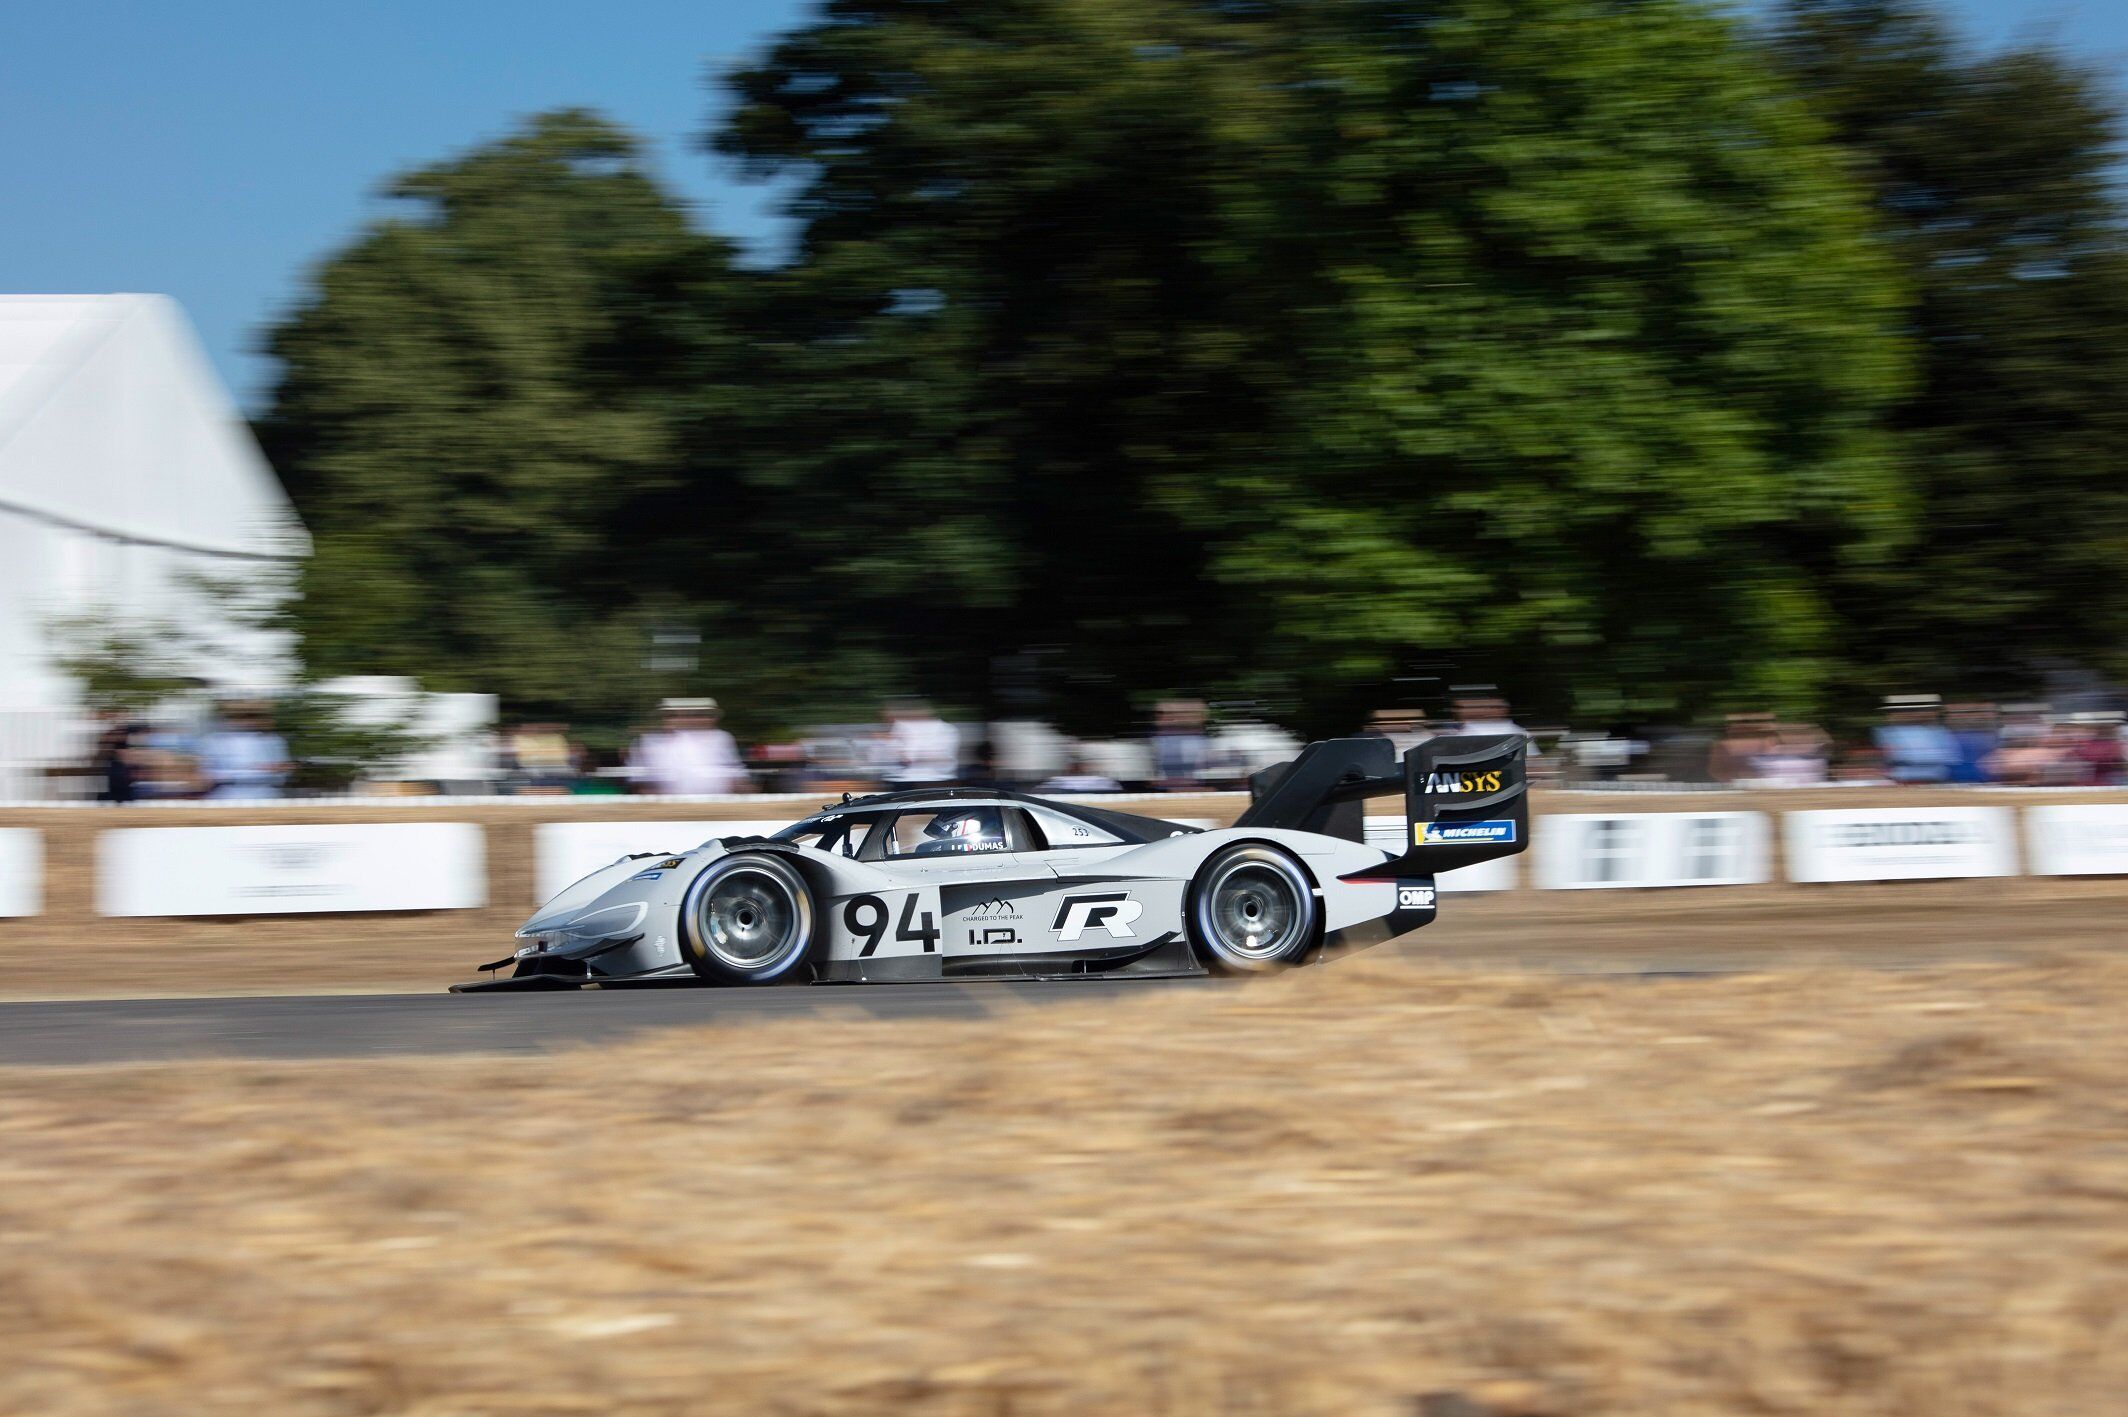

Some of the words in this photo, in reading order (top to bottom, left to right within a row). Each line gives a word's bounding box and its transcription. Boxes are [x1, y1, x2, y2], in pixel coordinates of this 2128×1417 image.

[1424, 770, 1502, 793] ANSYS
[1072, 827, 1089, 837] 253
[1443, 827, 1506, 837] MICHELIN
[972, 841, 1004, 851] DUMAS
[1399, 890, 1435, 905] OMP
[843, 892, 941, 958] 94
